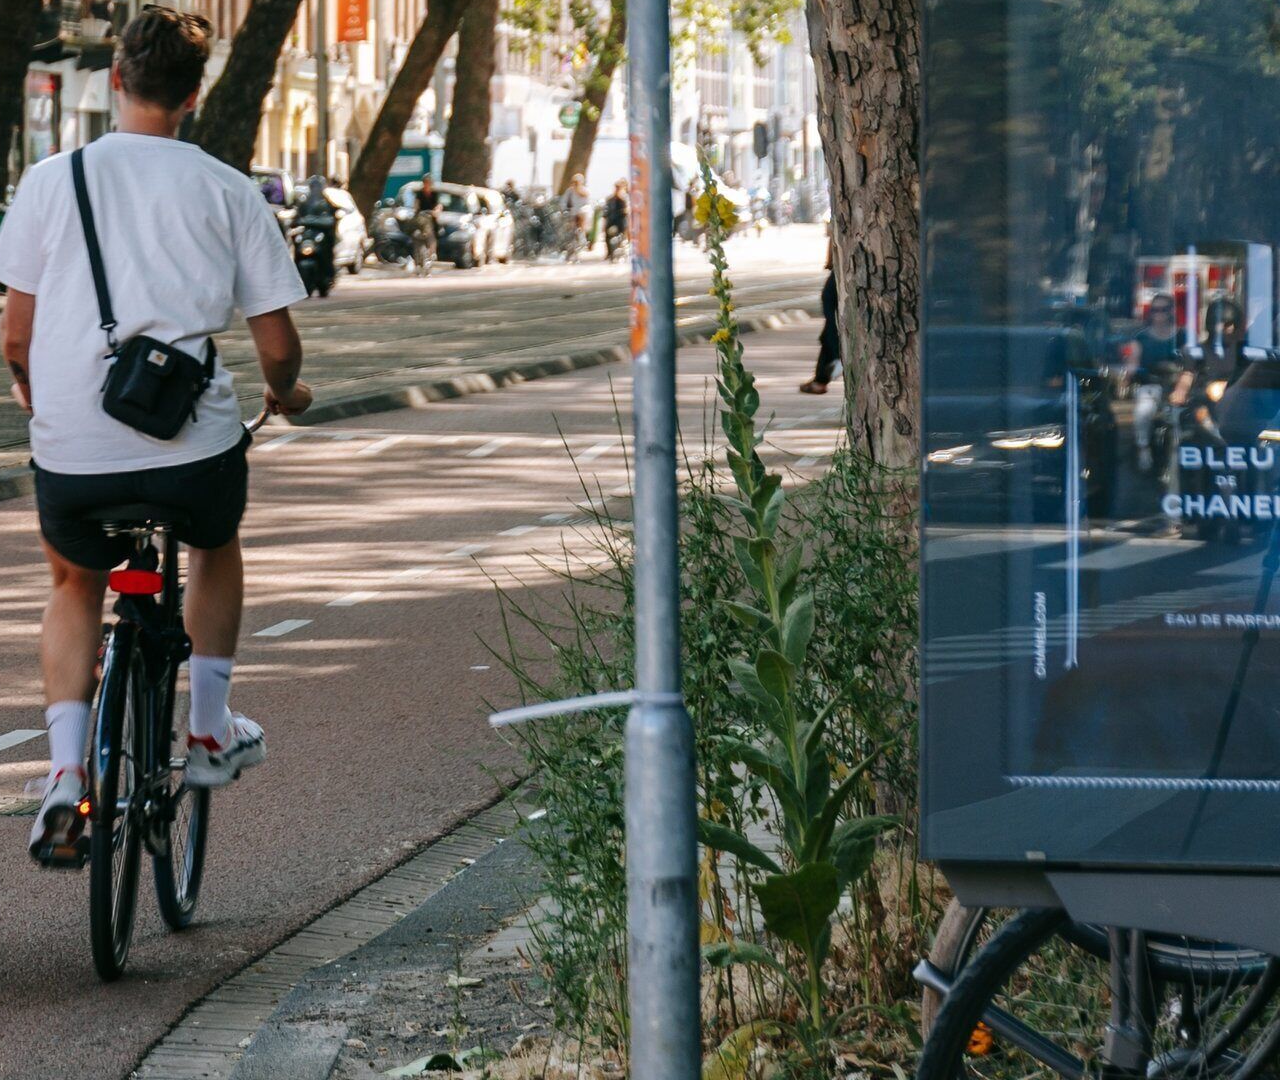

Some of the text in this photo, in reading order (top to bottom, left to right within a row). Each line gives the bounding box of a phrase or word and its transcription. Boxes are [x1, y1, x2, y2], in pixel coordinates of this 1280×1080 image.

[1179, 446, 1275, 470] BLEU
[1215, 475, 1238, 488] DE
[1164, 612, 1198, 628] EAU
[1200, 612, 1221, 628] DE
